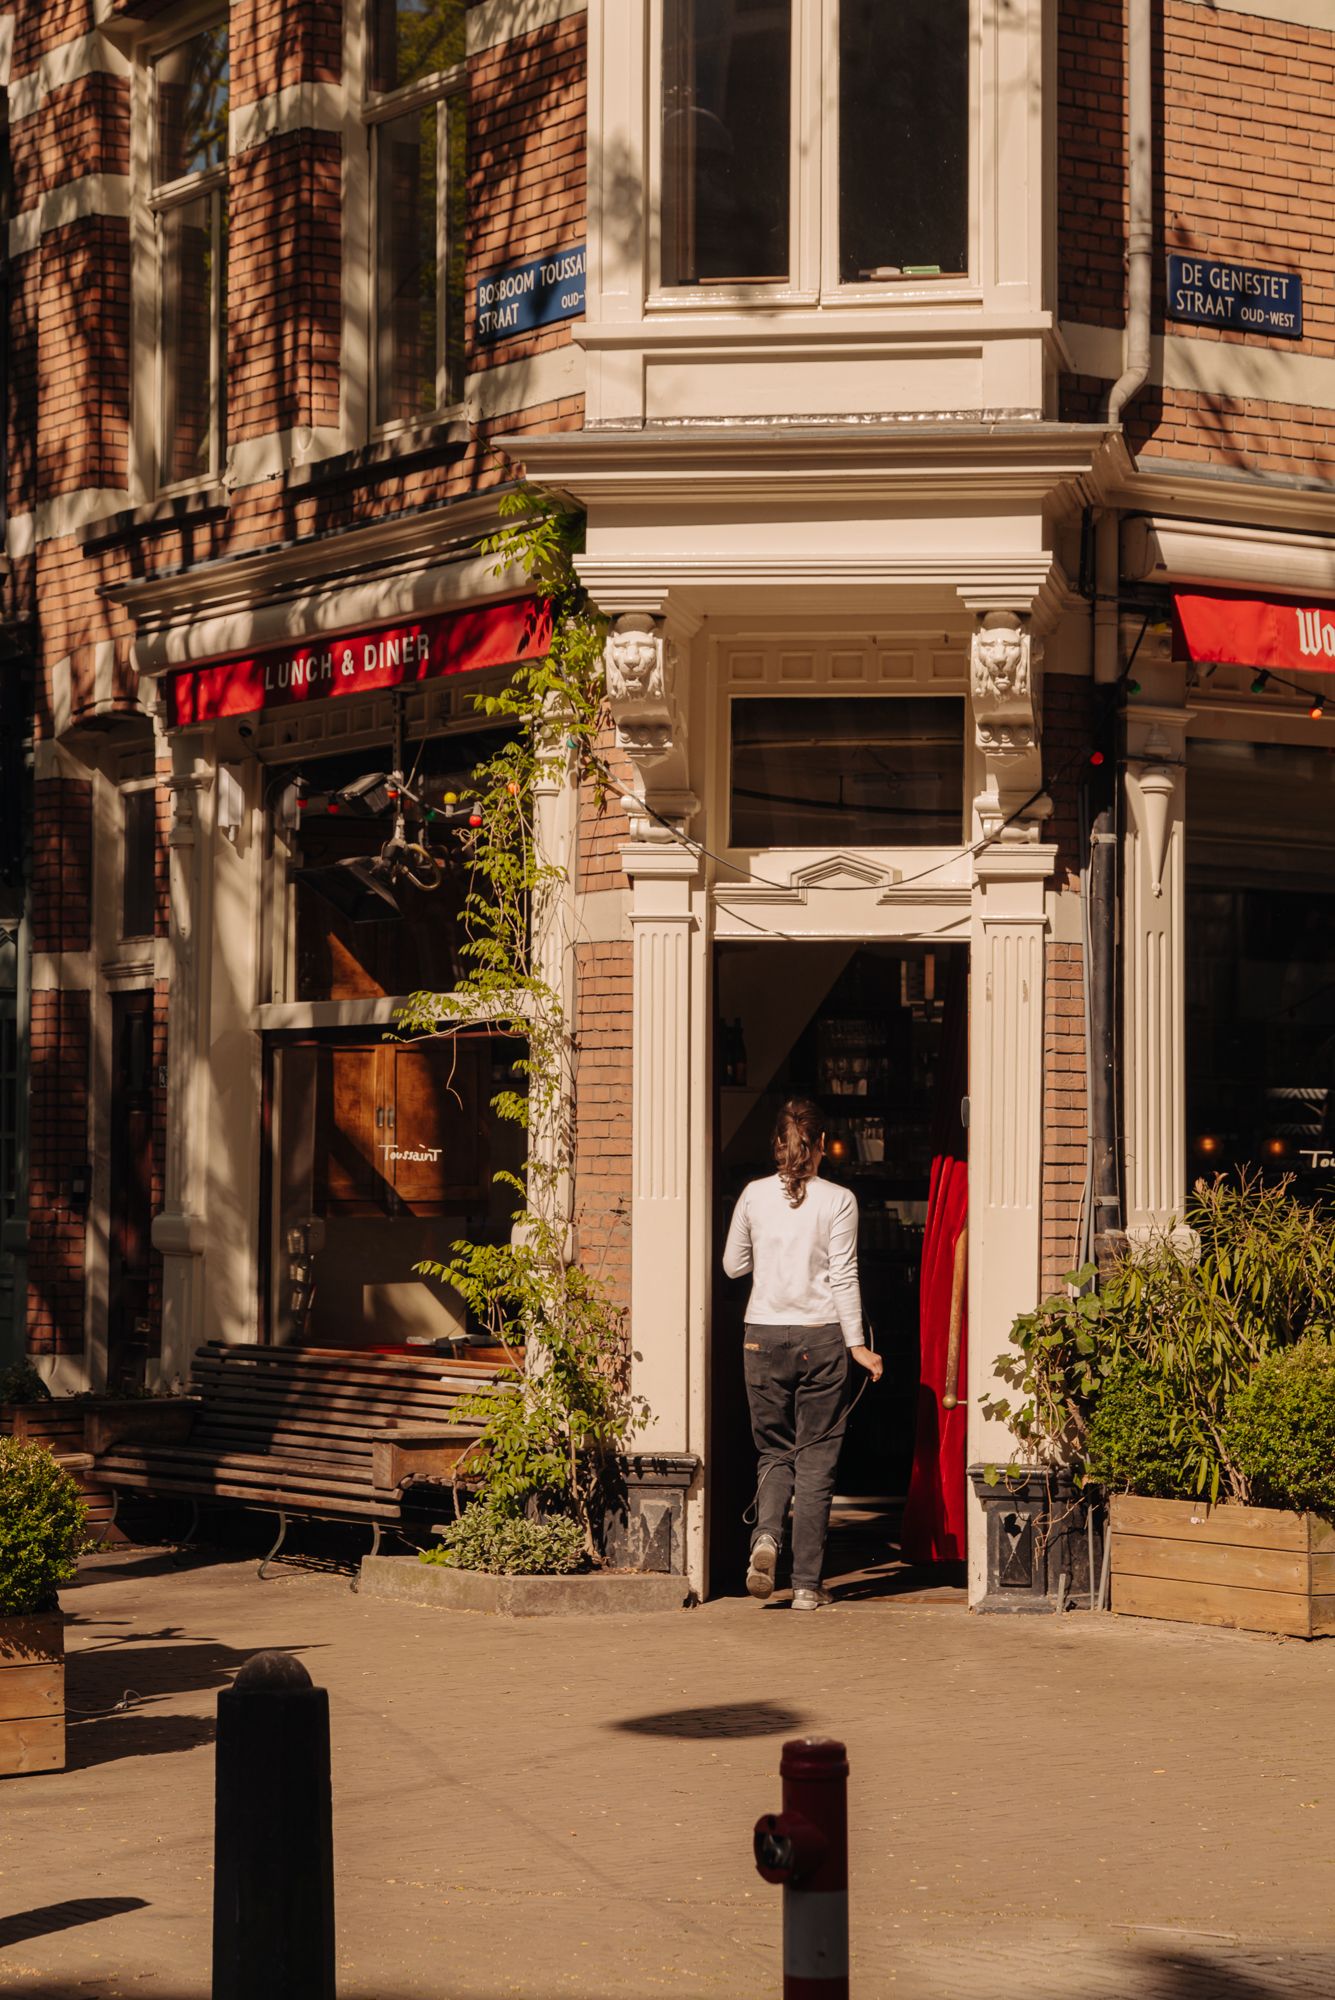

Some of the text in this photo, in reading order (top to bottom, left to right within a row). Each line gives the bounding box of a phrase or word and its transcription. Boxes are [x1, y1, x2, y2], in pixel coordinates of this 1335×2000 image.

[479, 270, 535, 307] BOSBOOM
[561, 289, 586, 309] OUD-
[1182, 262, 1289, 300] DE GENESTET
[479, 303, 519, 334] STRAAT
[1176, 290, 1295, 328] STRAAT OUD-WEST
[265, 634, 430, 690] LUNCH & DINER
